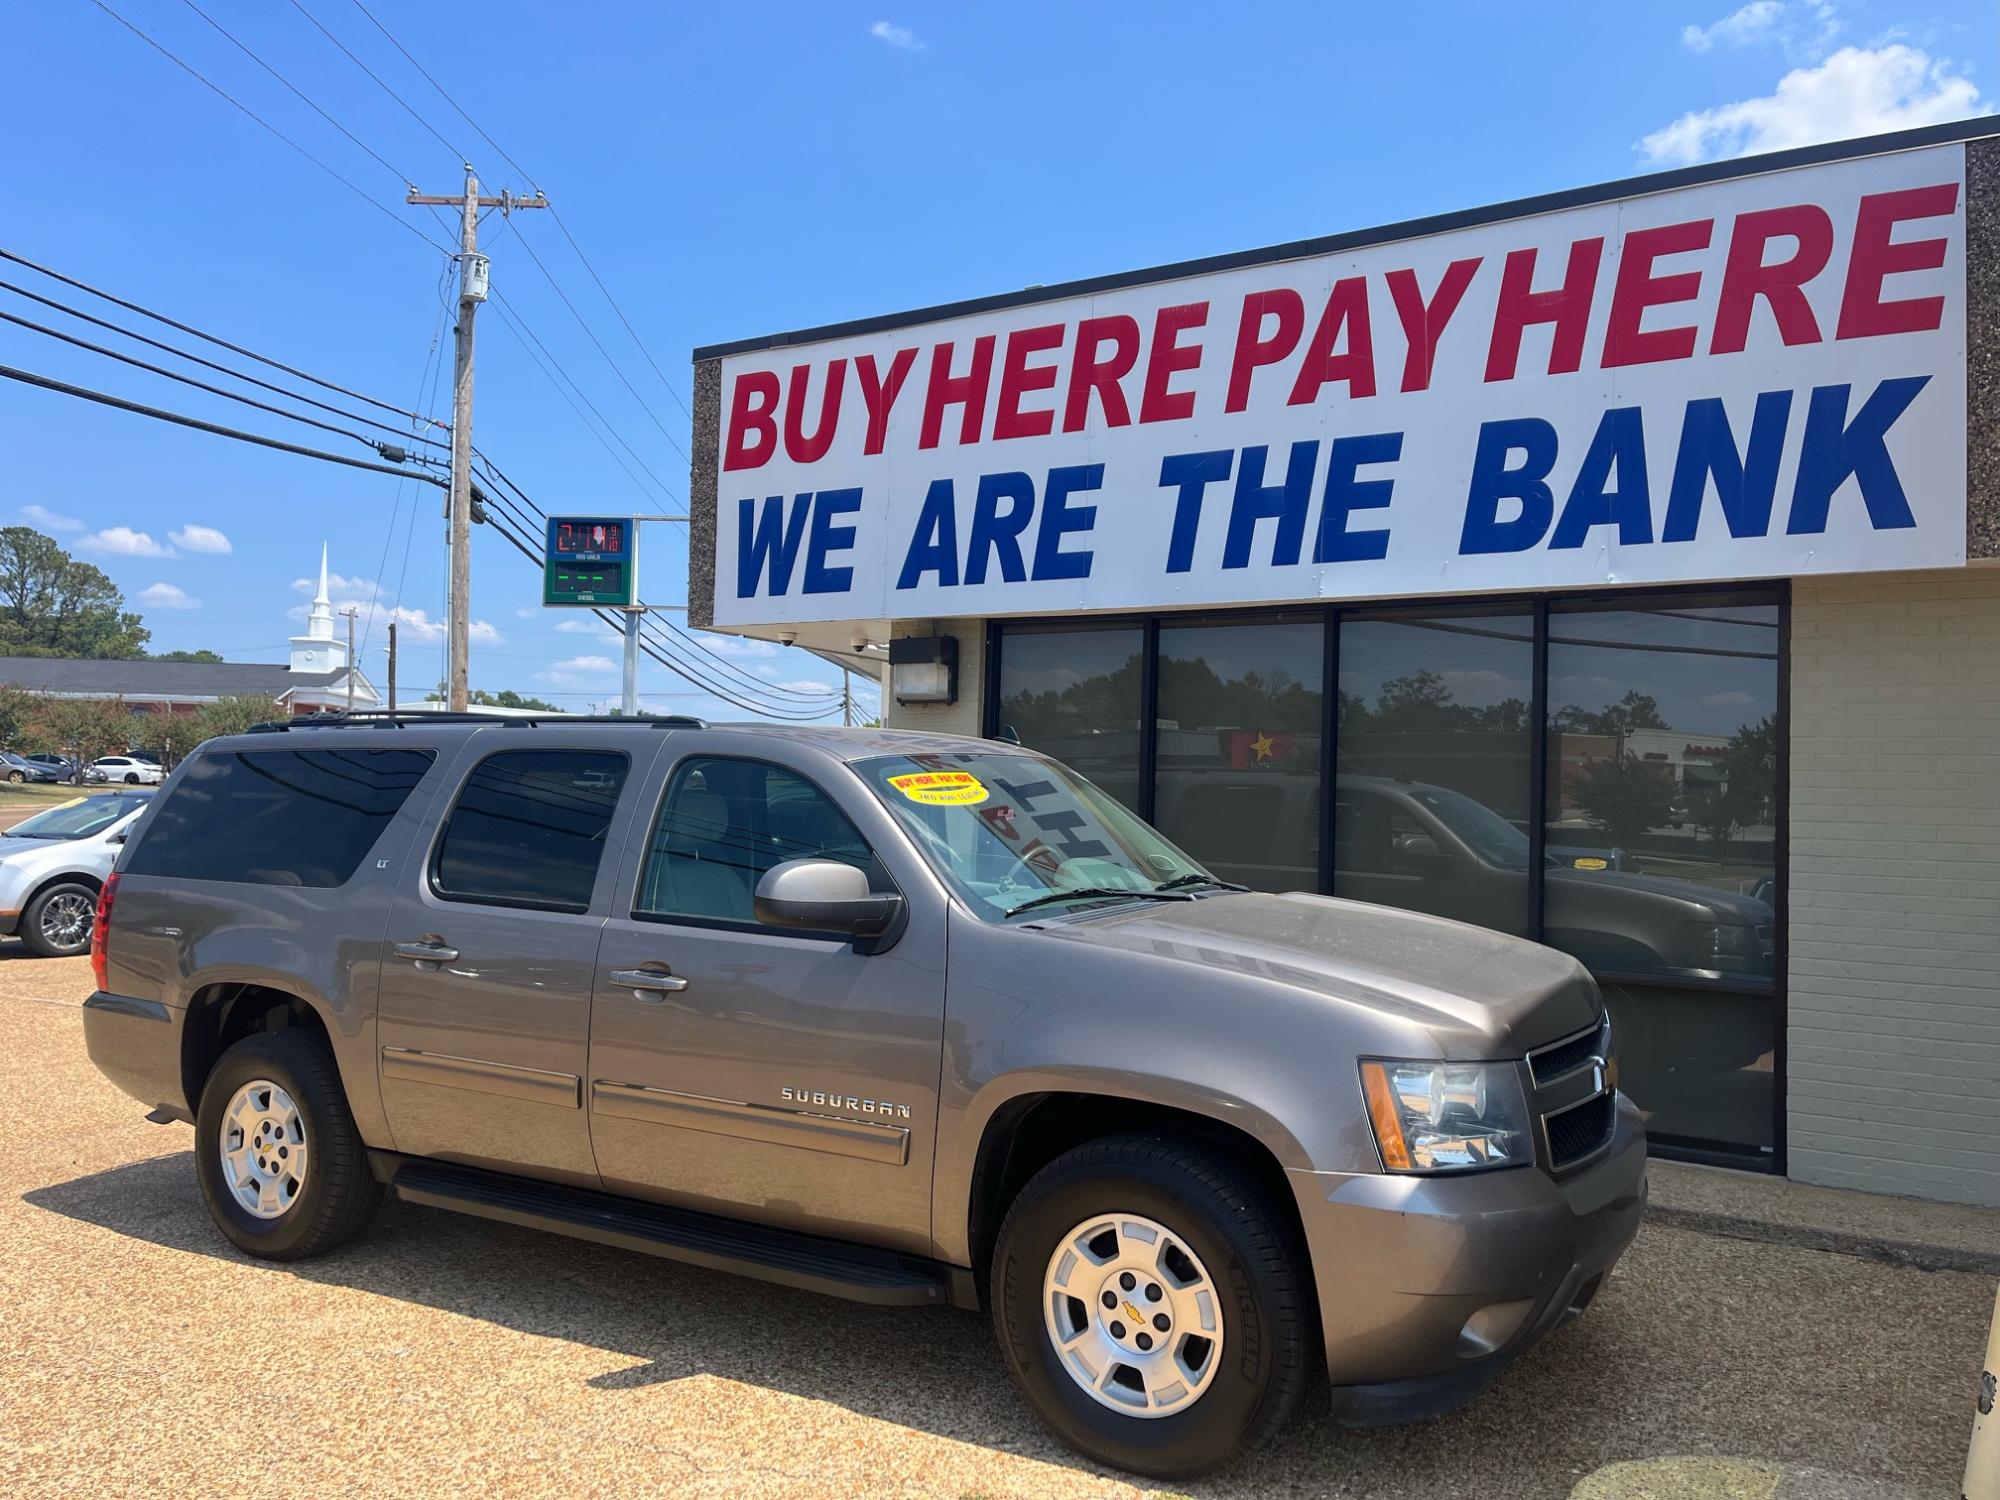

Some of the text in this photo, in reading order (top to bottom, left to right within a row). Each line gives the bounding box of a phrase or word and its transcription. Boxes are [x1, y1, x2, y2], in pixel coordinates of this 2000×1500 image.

[723, 183, 1960, 472] BUY HERE PAY HERE
[736, 375, 1934, 599] WE ARE THE BANK
[896, 778, 913, 788] BUY
[938, 775, 954, 783] PAY
[781, 1087, 911, 1118] SUBURBAN
